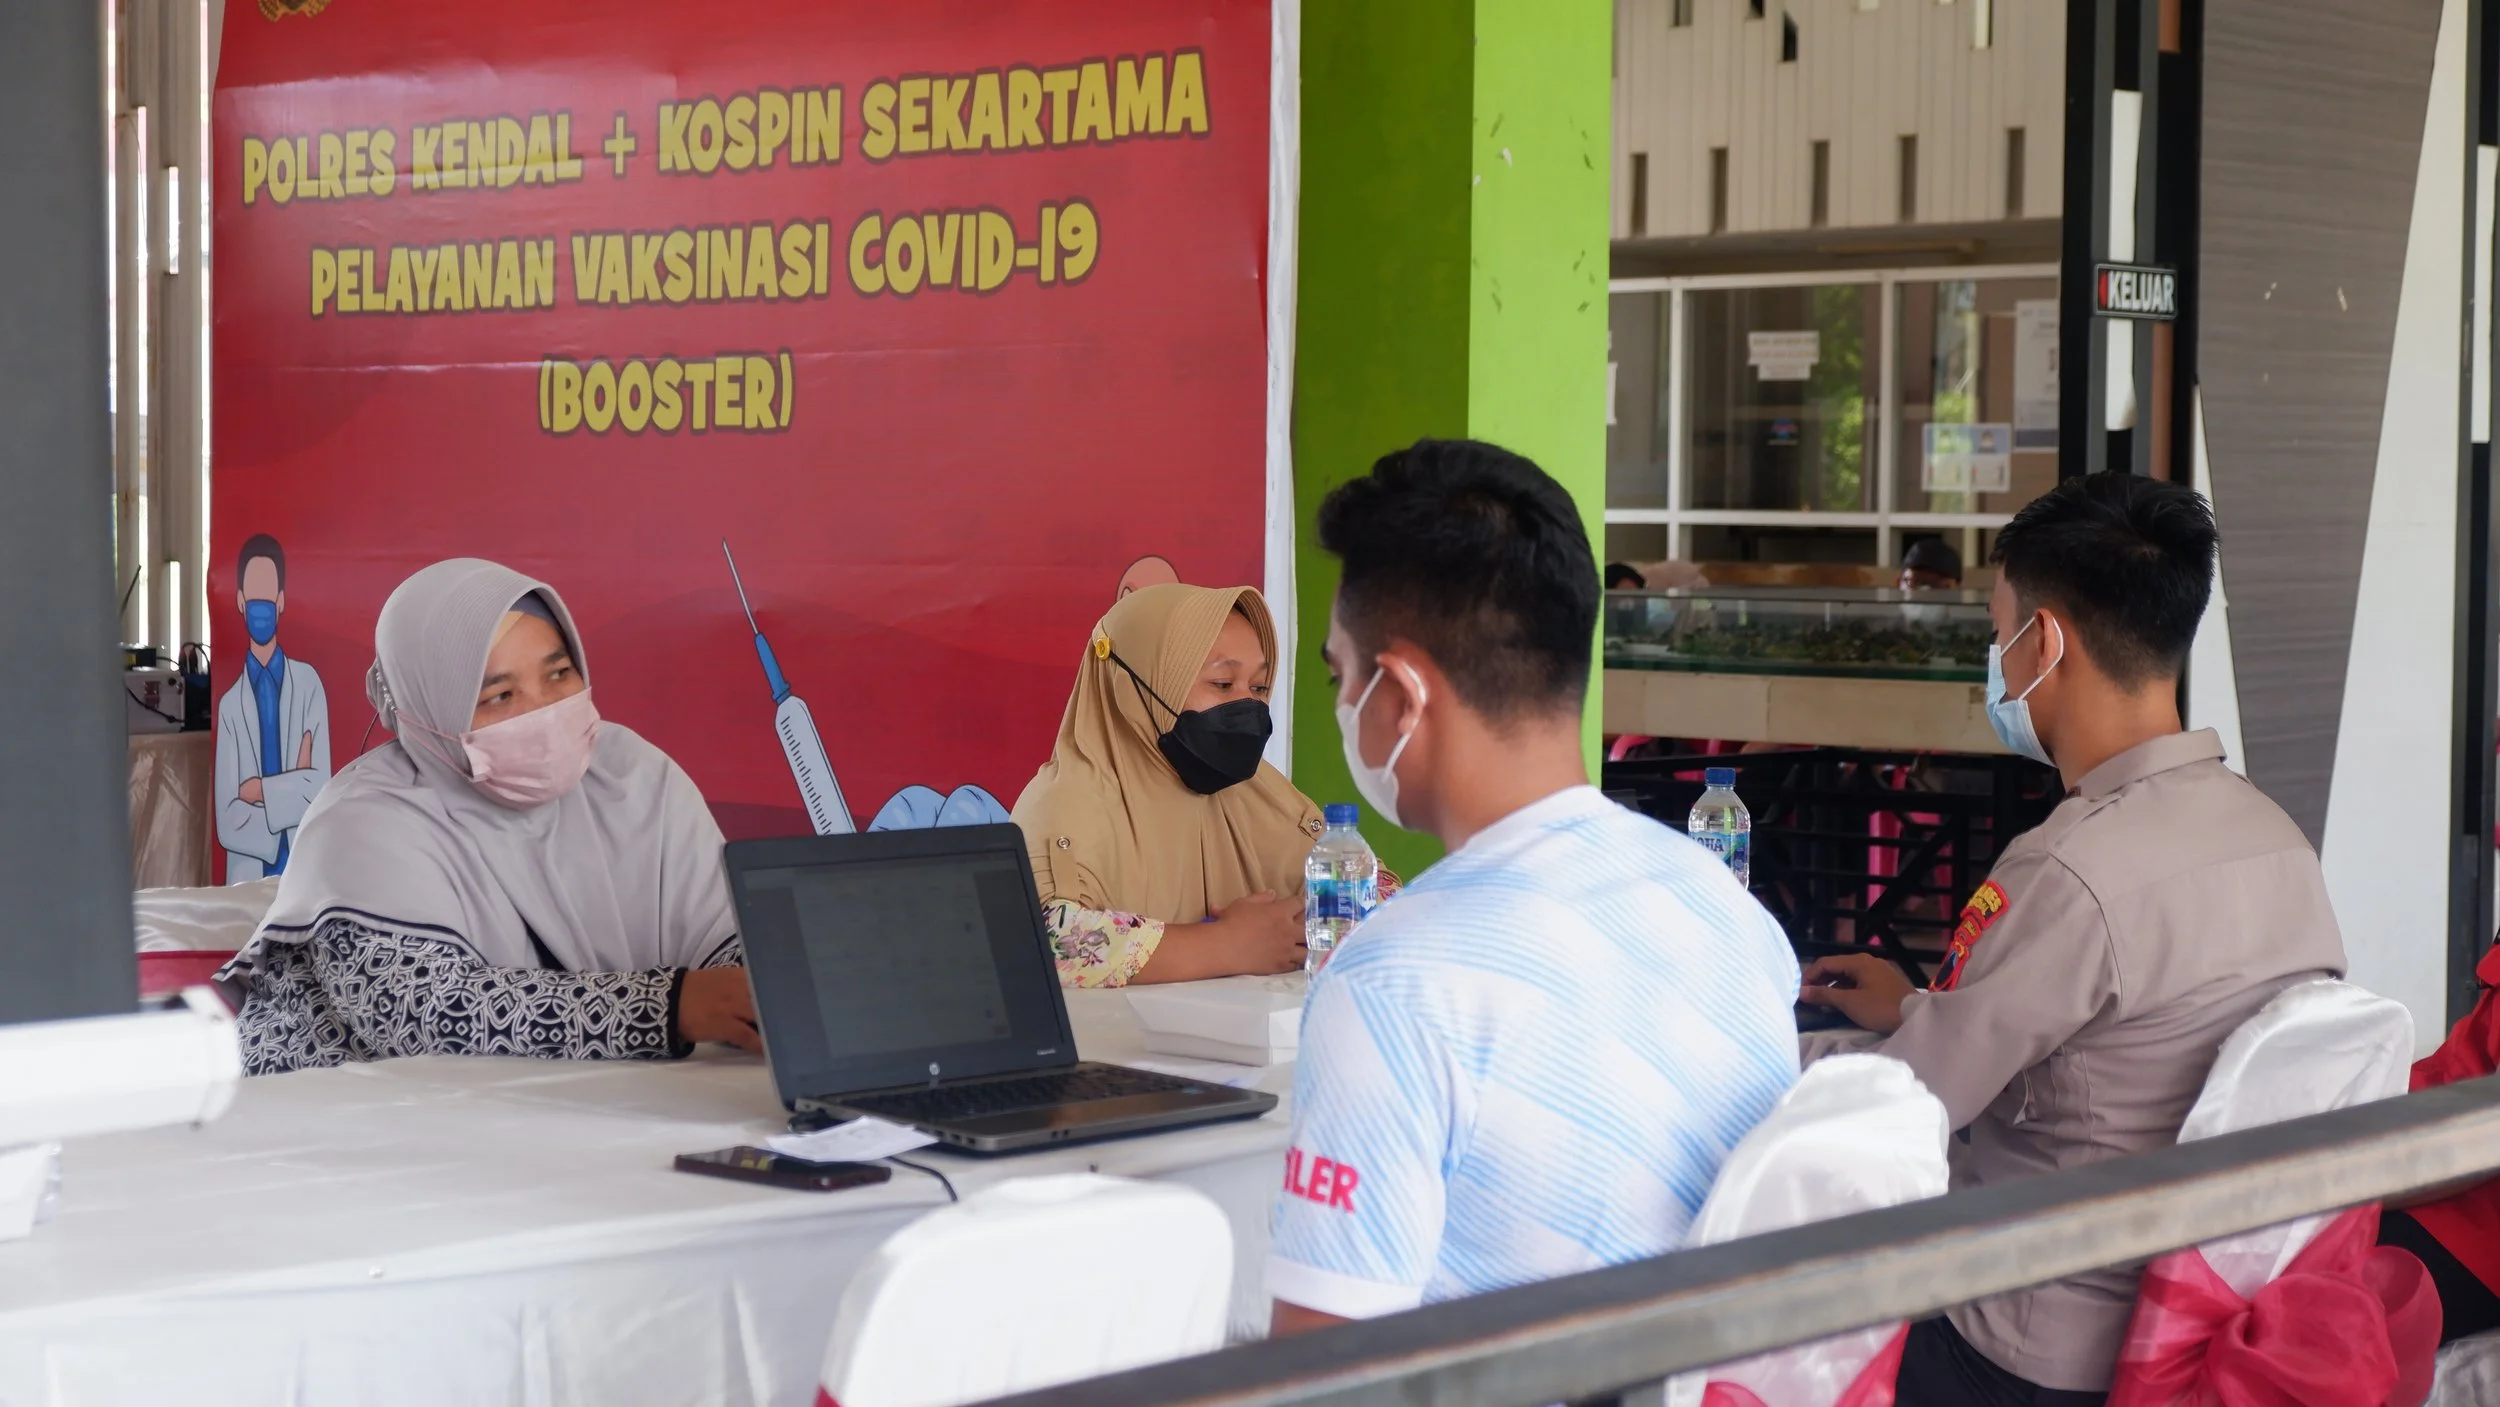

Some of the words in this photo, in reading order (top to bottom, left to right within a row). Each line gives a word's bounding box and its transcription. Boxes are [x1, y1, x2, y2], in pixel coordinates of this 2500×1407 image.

[243, 130, 397, 204] POLRES
[411, 112, 584, 191] KENDAL
[604, 116, 636, 175] +
[658, 88, 842, 172] KOSPIN
[861, 51, 1209, 162] SEKARTAMA
[310, 238, 556, 316] PELAYANAN
[571, 223, 830, 304] VAKSINASI
[848, 201, 1100, 295] COVID-19
[2108, 270, 2174, 312] KELUAR
[539, 351, 794, 434] (BOOSTER)
